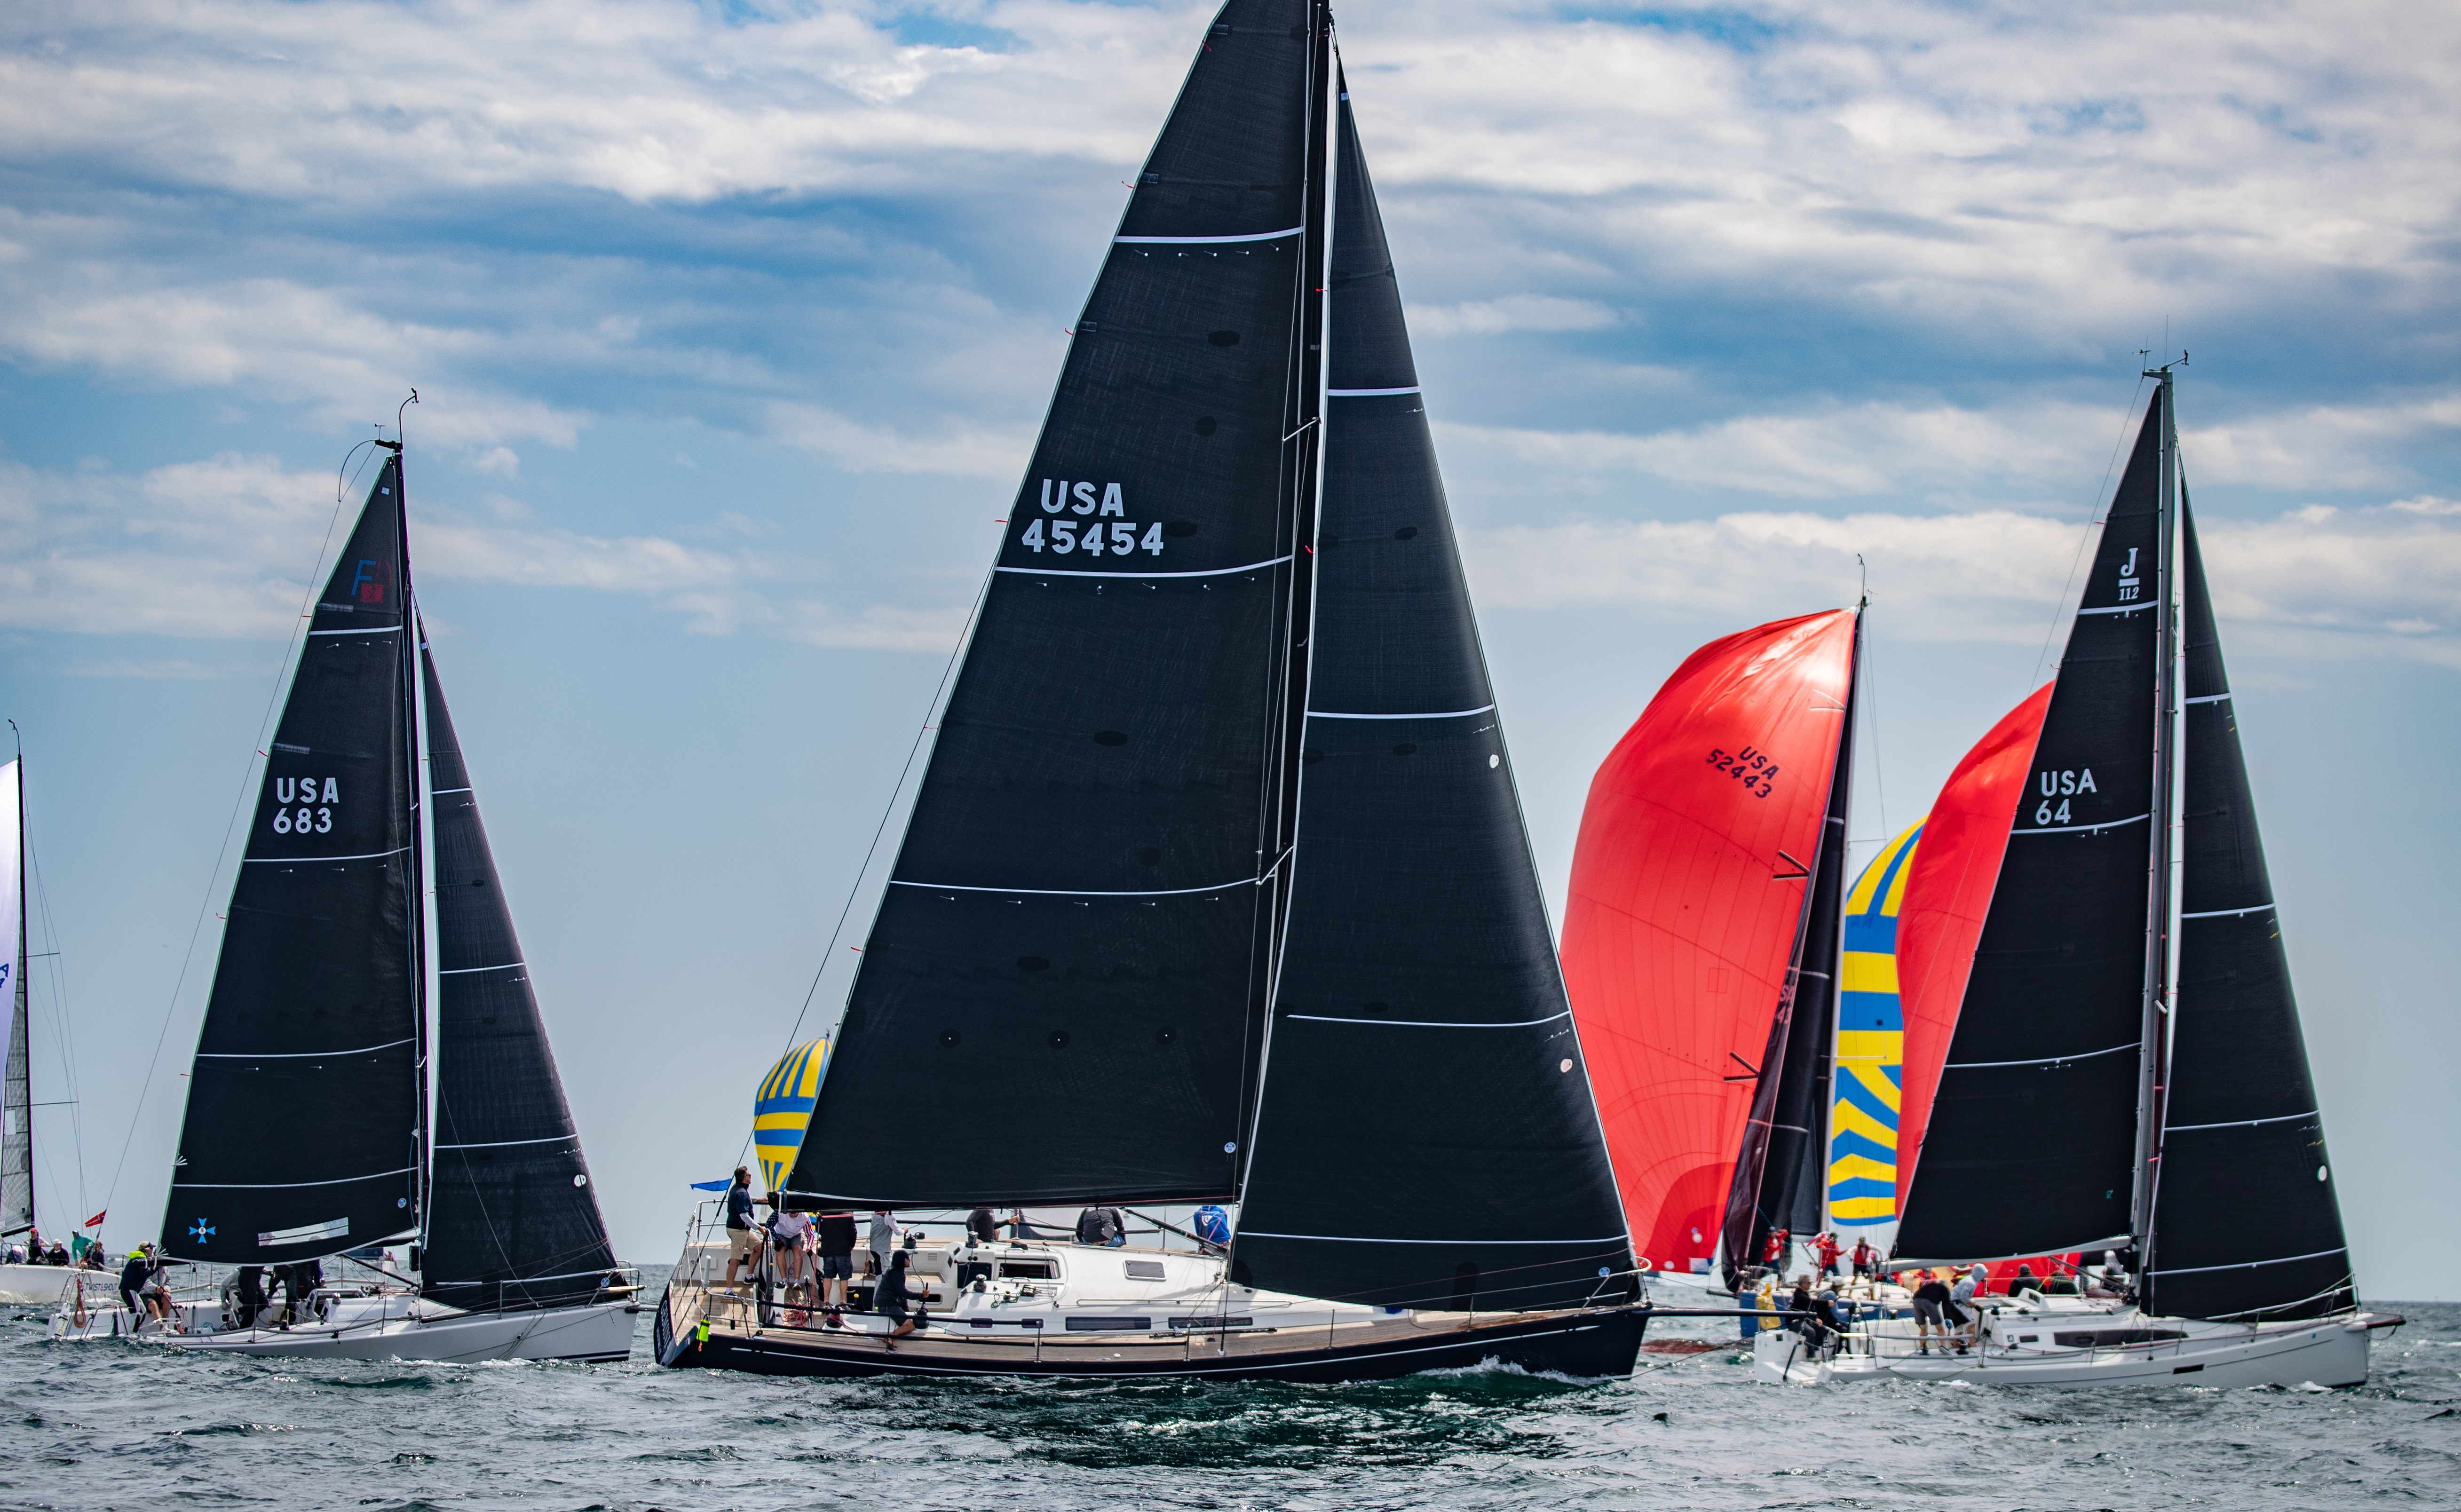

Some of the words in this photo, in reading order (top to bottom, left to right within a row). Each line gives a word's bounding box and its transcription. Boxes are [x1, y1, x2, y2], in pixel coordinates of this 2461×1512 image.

[1041, 479, 1124, 516] USA
[1021, 519, 1164, 556] 45454
[2121, 547, 2138, 576] J
[2119, 586, 2139, 601] 112
[1707, 748, 1772, 798] 52443
[1740, 746, 1780, 780] USA
[277, 777, 339, 803] USA
[2042, 768, 2097, 797] USA
[273, 807, 332, 834] 683
[2036, 799, 2071, 825] 64
